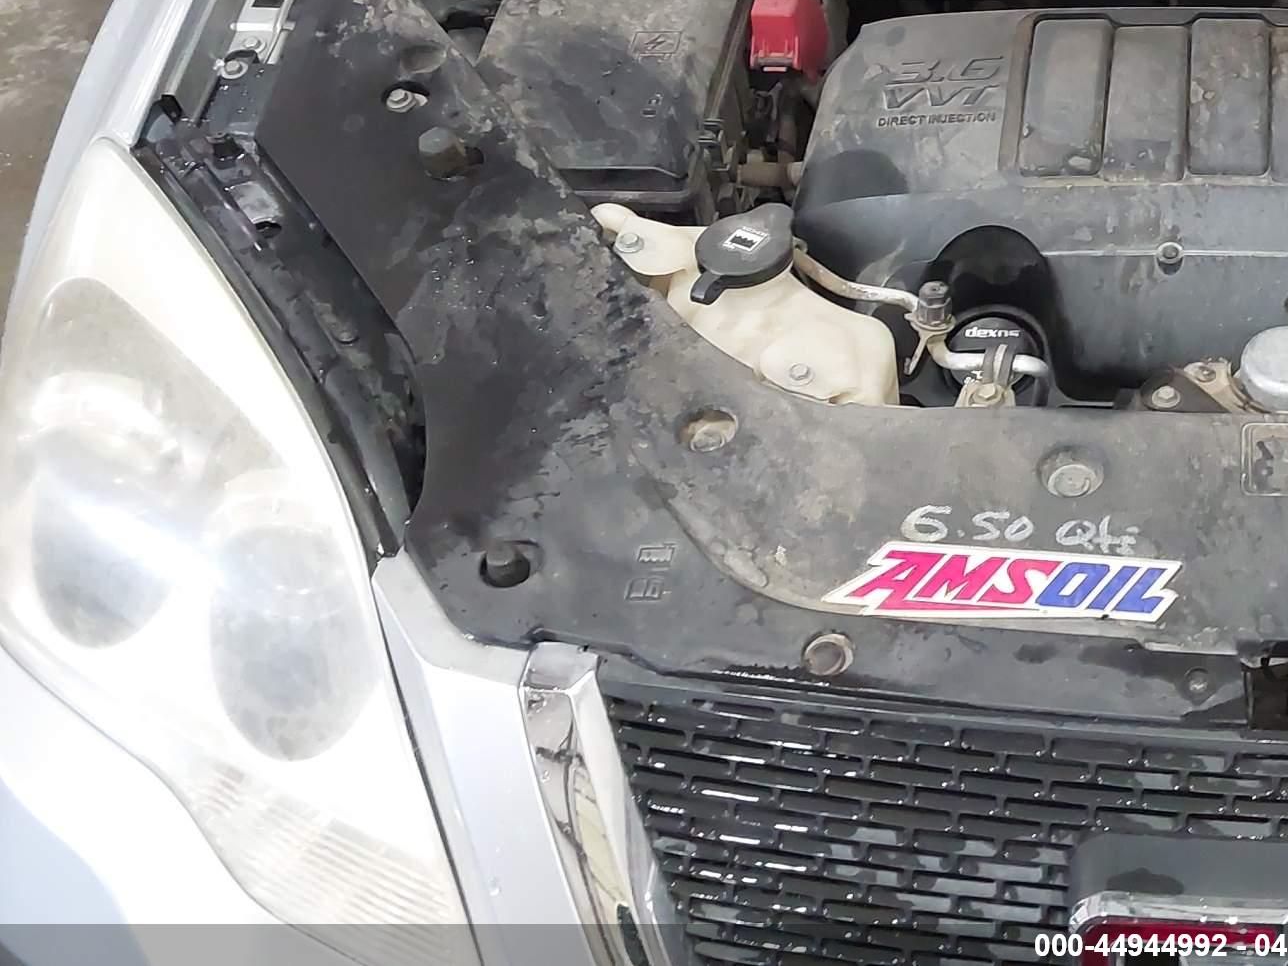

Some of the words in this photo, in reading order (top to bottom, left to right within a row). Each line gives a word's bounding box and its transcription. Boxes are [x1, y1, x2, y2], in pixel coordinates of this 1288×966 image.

[885, 56, 1003, 86] 3.6
[882, 84, 1000, 109] VVT
[877, 115, 926, 128] DIRECT
[928, 112, 997, 125] INJECTION
[900, 504, 1034, 542] 6.50
[847, 550, 1167, 614] AMSOIL
